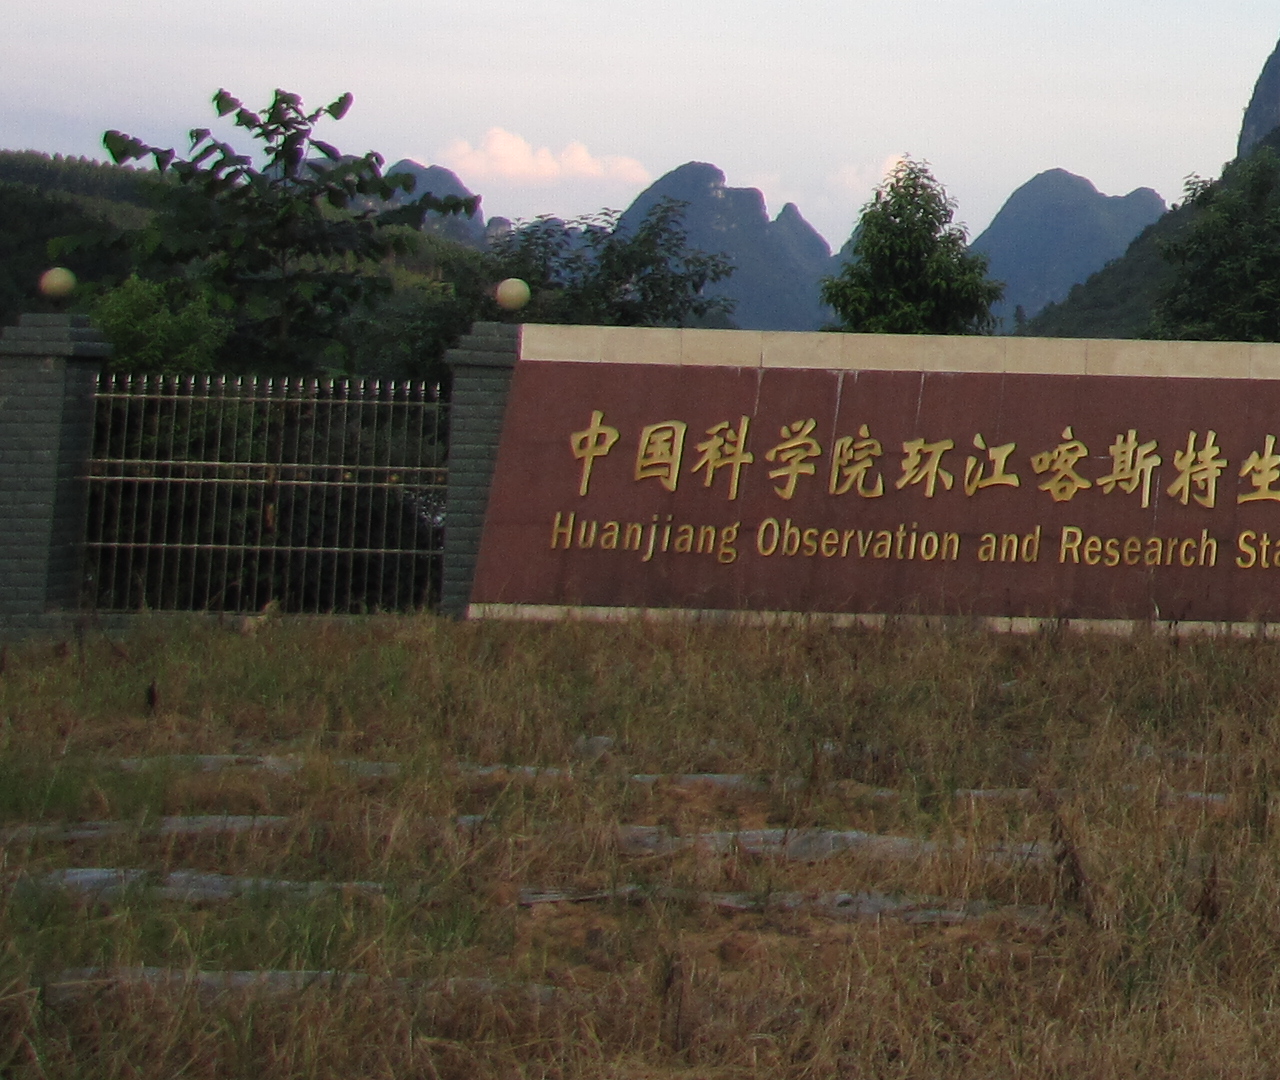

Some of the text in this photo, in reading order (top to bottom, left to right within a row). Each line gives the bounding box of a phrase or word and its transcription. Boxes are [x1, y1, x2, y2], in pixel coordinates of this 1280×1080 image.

[550, 510, 741, 564] Huanjiang
[756, 516, 962, 562] Observation
[977, 524, 1042, 563] and
[1058, 525, 1219, 568] Research
